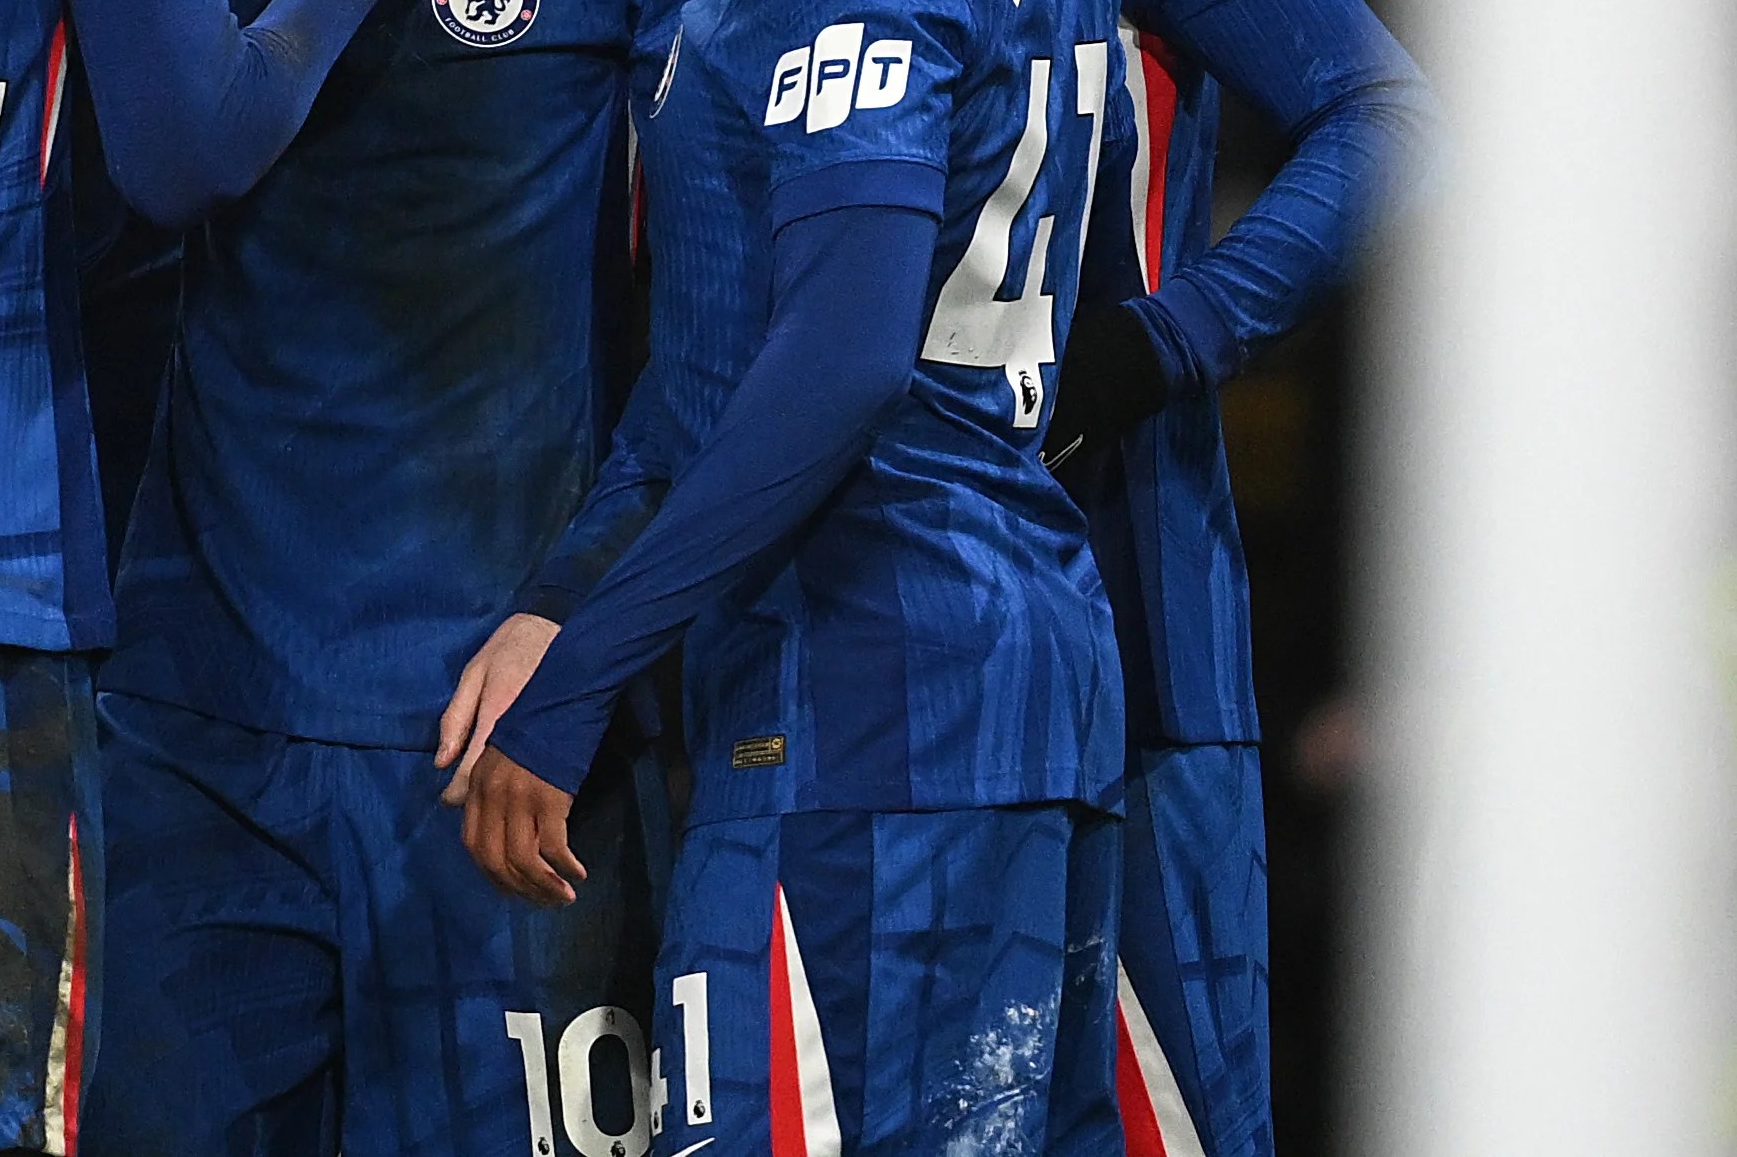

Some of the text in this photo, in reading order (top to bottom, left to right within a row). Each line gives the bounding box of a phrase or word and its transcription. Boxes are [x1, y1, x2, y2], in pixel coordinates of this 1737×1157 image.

[444, 17, 515, 42] FOOTBALL CLUB
[920, 41, 1108, 429] 41
[505, 1005, 651, 1157] 10
